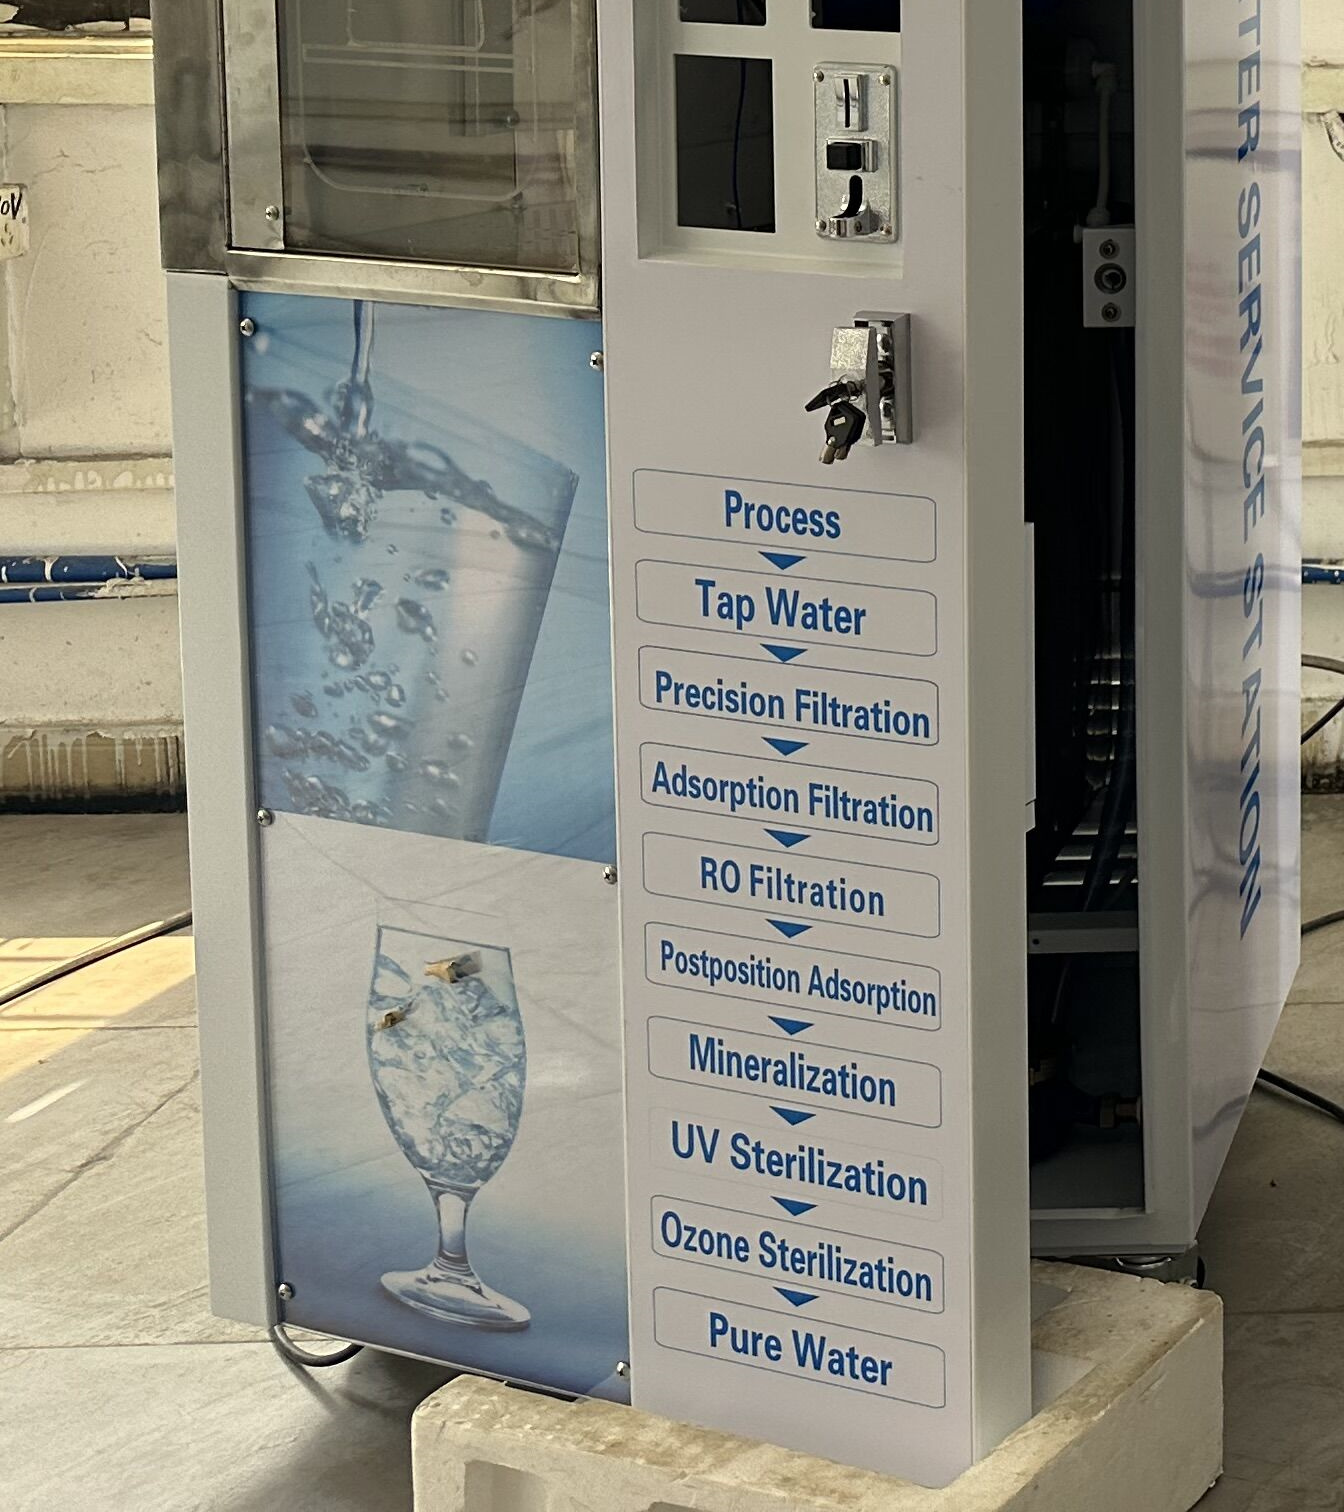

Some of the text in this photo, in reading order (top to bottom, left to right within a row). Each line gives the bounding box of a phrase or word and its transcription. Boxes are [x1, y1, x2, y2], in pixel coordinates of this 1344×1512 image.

[1236, 180, 1266, 544] SERVICE
[725, 489, 841, 539] Process
[695, 579, 866, 635] Tap Water
[655, 670, 930, 738] Precision Filtration
[1239, 550, 1265, 941] STATION
[652, 761, 933, 832] Adsorption Filtration
[701, 856, 884, 916] RO Filtration
[660, 940, 936, 1016] Postposition Adsorption
[689, 1033, 896, 1107] Mineralization
[671, 1120, 928, 1205] UV Sterilization
[661, 1211, 932, 1301] Ozone Sterilization
[709, 1312, 893, 1386] Pure Water
